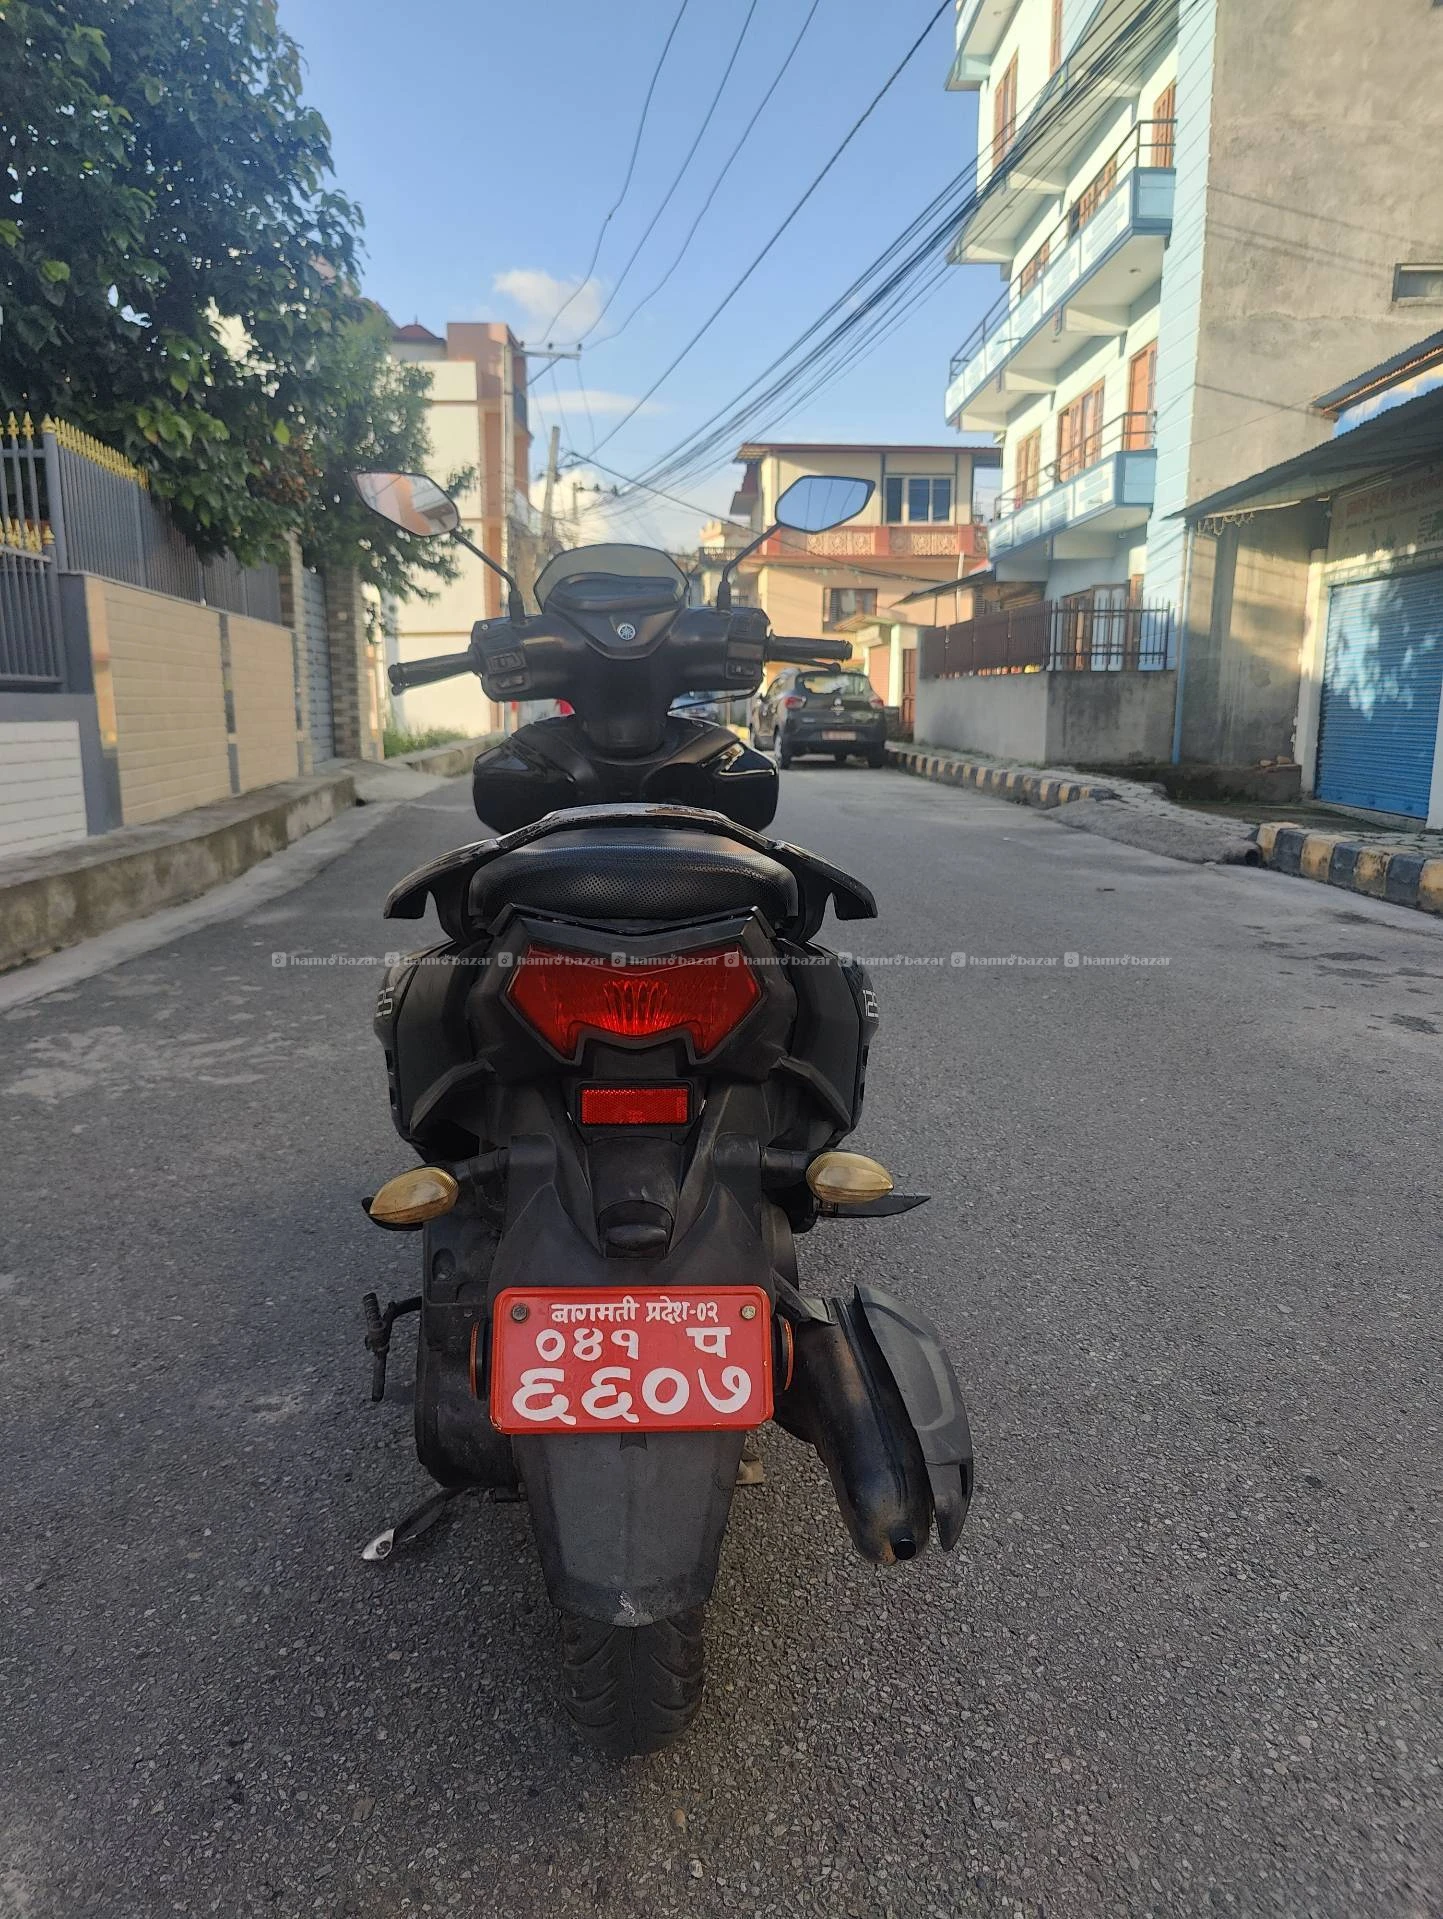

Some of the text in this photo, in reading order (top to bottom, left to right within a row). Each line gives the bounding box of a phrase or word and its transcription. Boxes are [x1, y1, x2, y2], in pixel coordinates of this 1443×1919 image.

[551, 1295, 640, 1324] बागमती
[535, 1326, 732, 1362] ०४१ प
[511, 1365, 752, 1425] ६६०७
